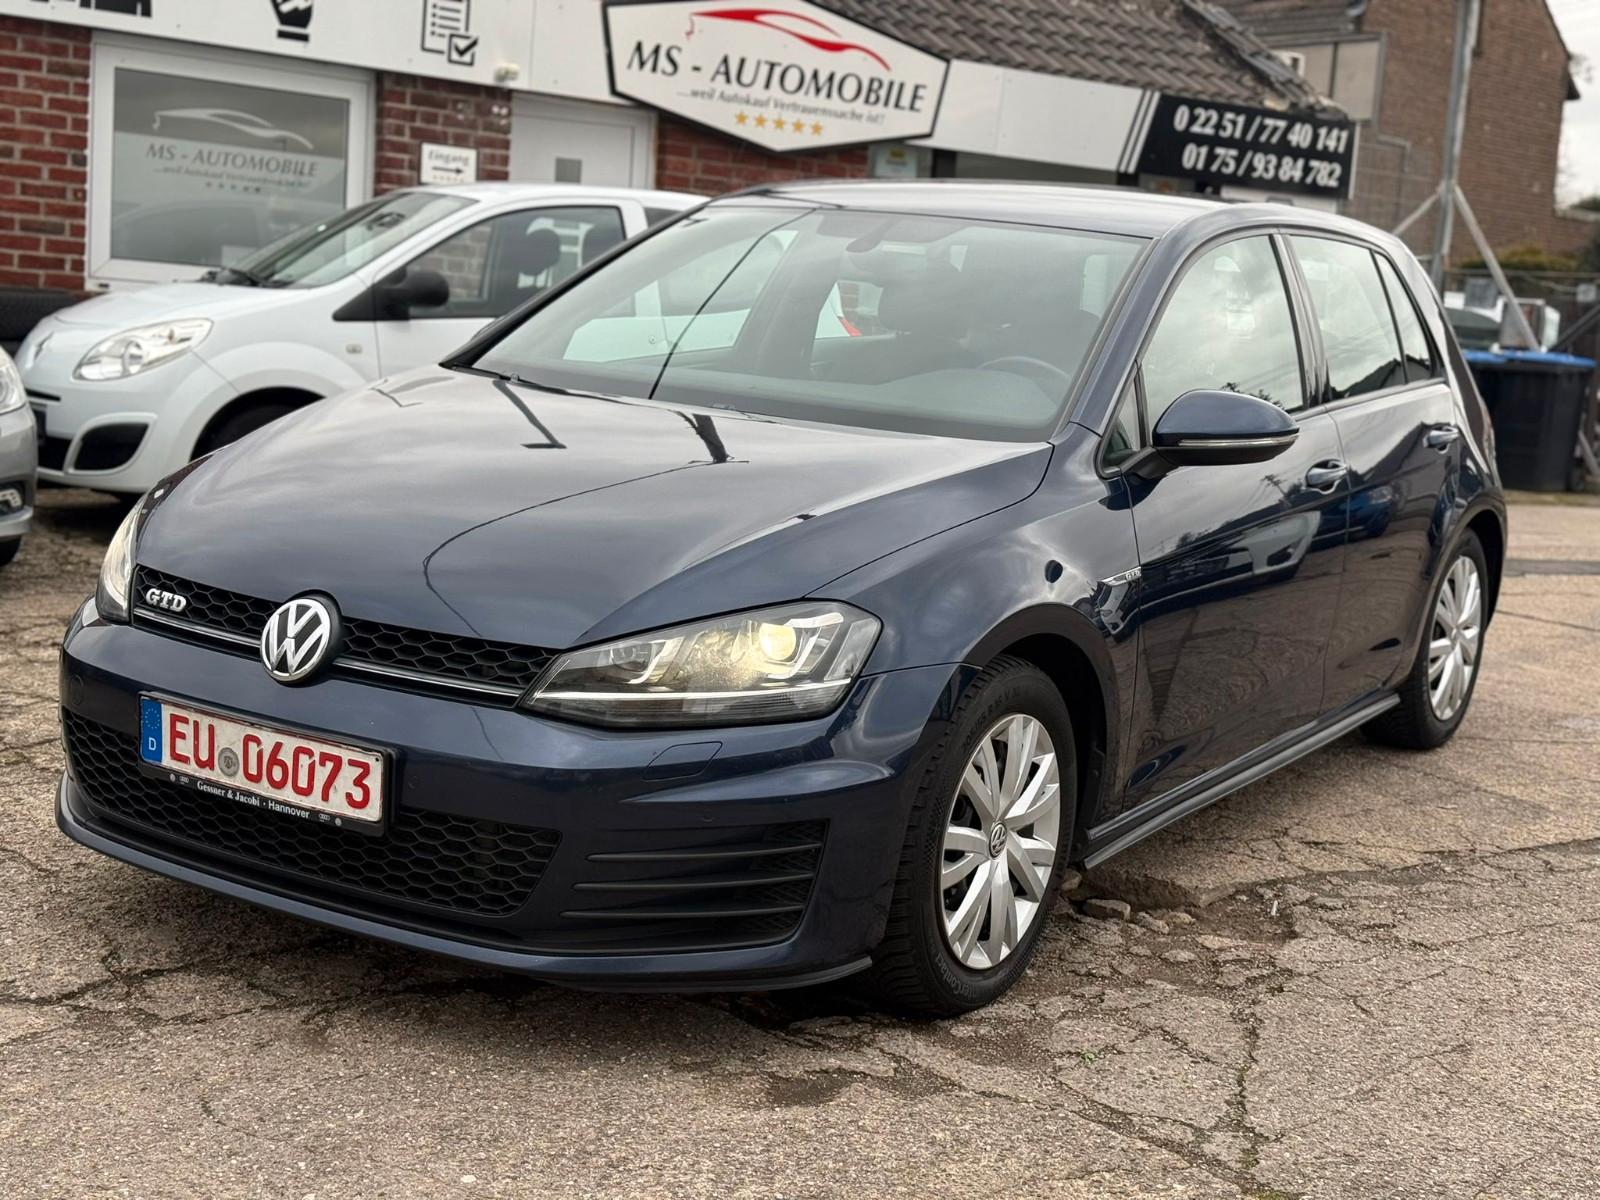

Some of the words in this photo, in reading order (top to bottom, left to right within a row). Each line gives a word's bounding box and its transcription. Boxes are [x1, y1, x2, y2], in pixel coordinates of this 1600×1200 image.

[627, 40, 682, 77] MS
[710, 54, 928, 113] AUTOMOBILE
[145, 143, 177, 161] MS
[192, 149, 319, 177] AUTOMOBILE
[428, 149, 470, 167] Eingang
[145, 588, 187, 612] GTD
[148, 737, 157, 751] D
[169, 713, 215, 771] EU
[242, 733, 371, 810] 06073
[196, 780, 226, 797] Gessner
[227, 789, 234, 799] &
[234, 793, 260, 807] Jacobi
[268, 800, 311, 819] Hannover
